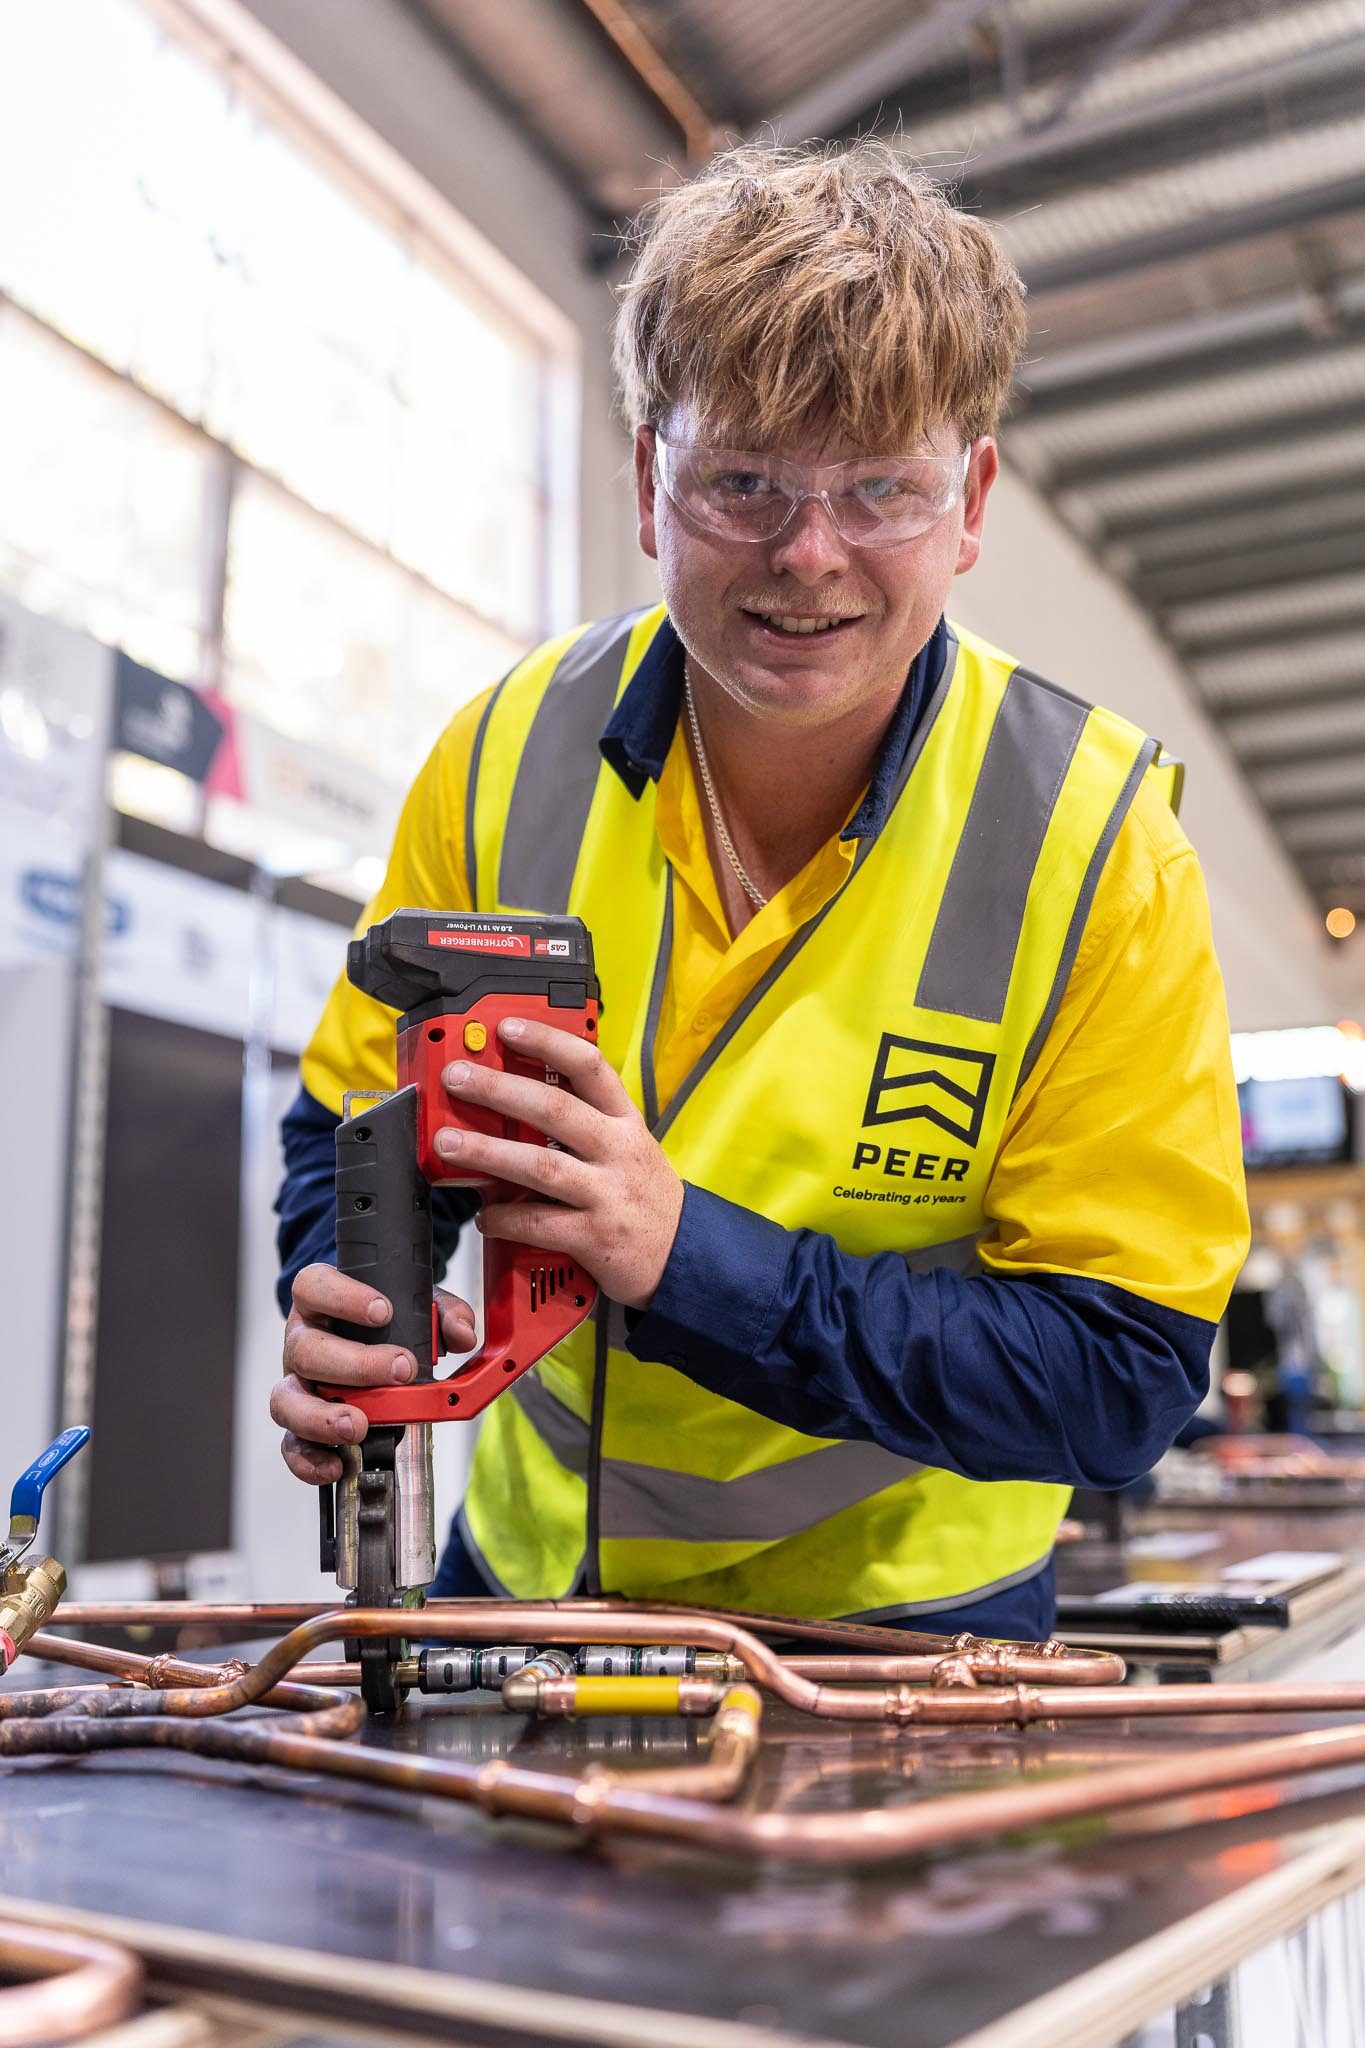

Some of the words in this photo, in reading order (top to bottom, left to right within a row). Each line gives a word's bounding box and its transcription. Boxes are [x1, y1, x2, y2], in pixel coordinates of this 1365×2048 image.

[446, 922, 476, 930] Li-Power
[440, 936, 514, 948] ROTHENBERGER
[852, 1142, 970, 1182] PEER
[833, 1186, 912, 1205] Celebrating
[913, 1194, 930, 1204] 40
[931, 1194, 968, 1205] years
